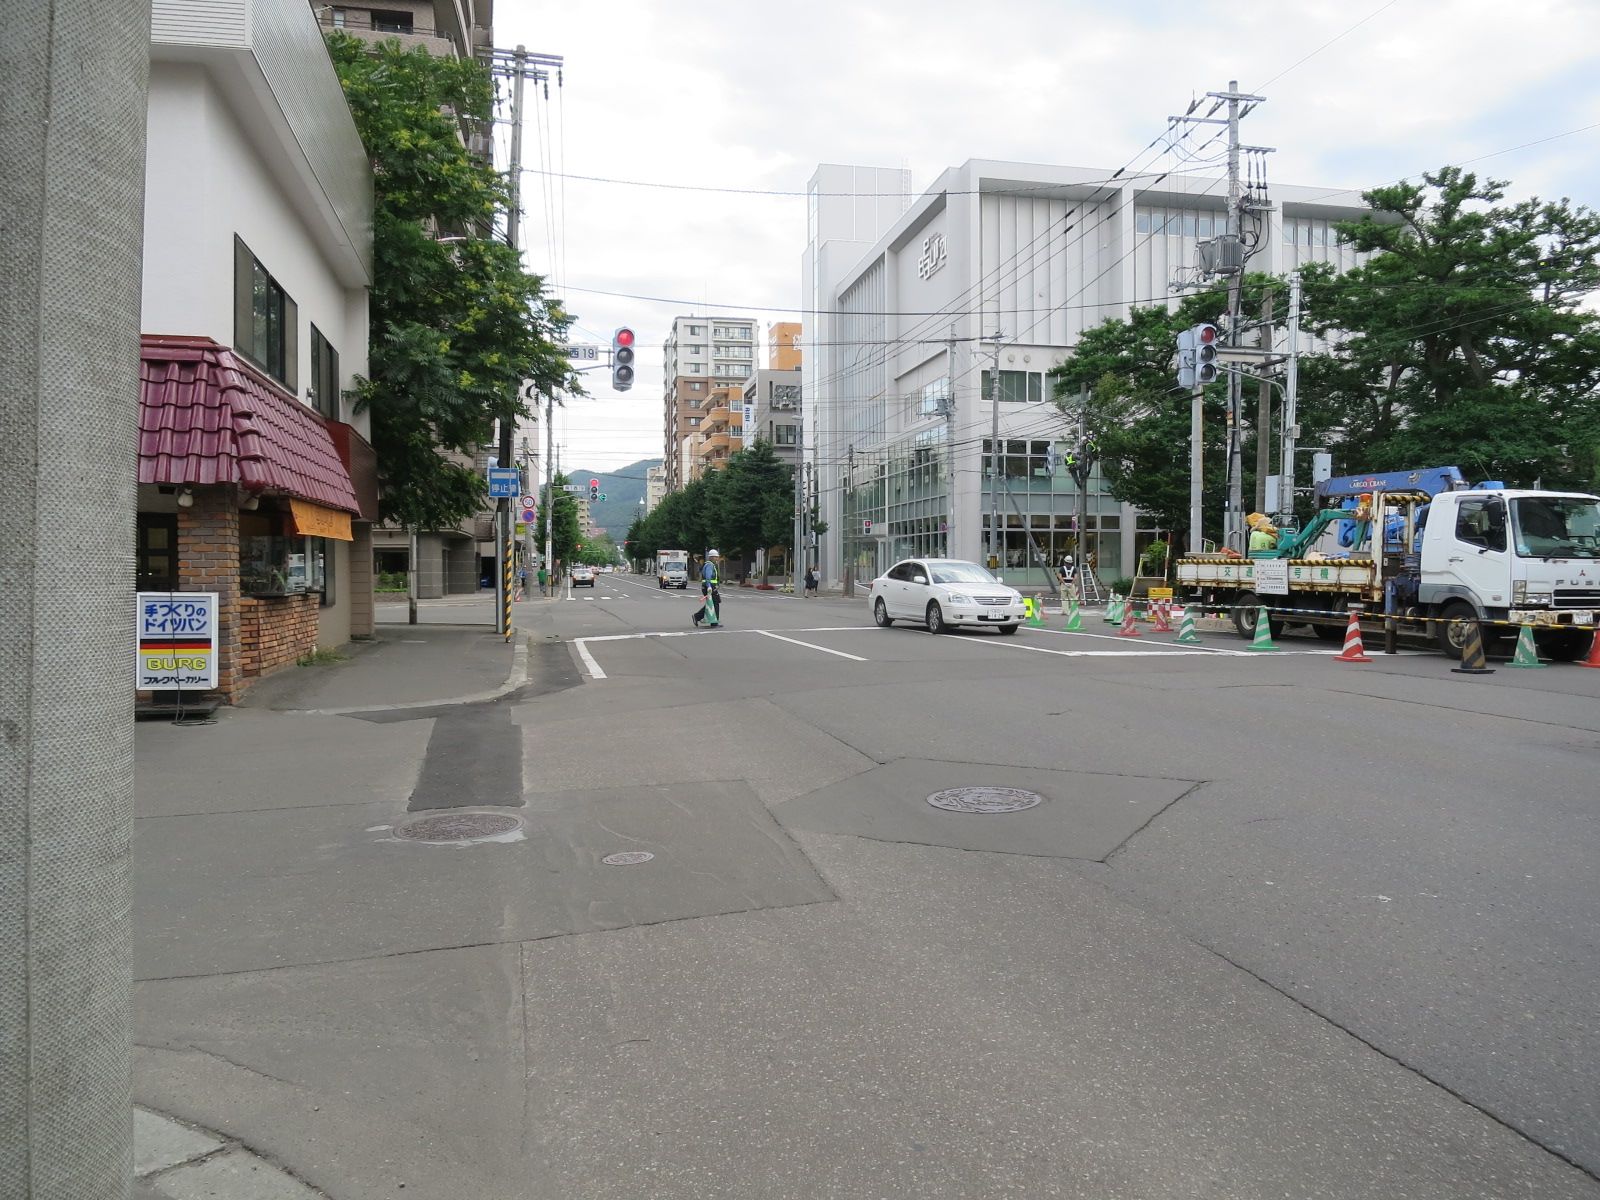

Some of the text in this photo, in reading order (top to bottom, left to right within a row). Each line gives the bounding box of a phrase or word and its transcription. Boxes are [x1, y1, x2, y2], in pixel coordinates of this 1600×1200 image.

[145, 603, 206, 617] 手づくりの
[147, 658, 206, 671] BURG
